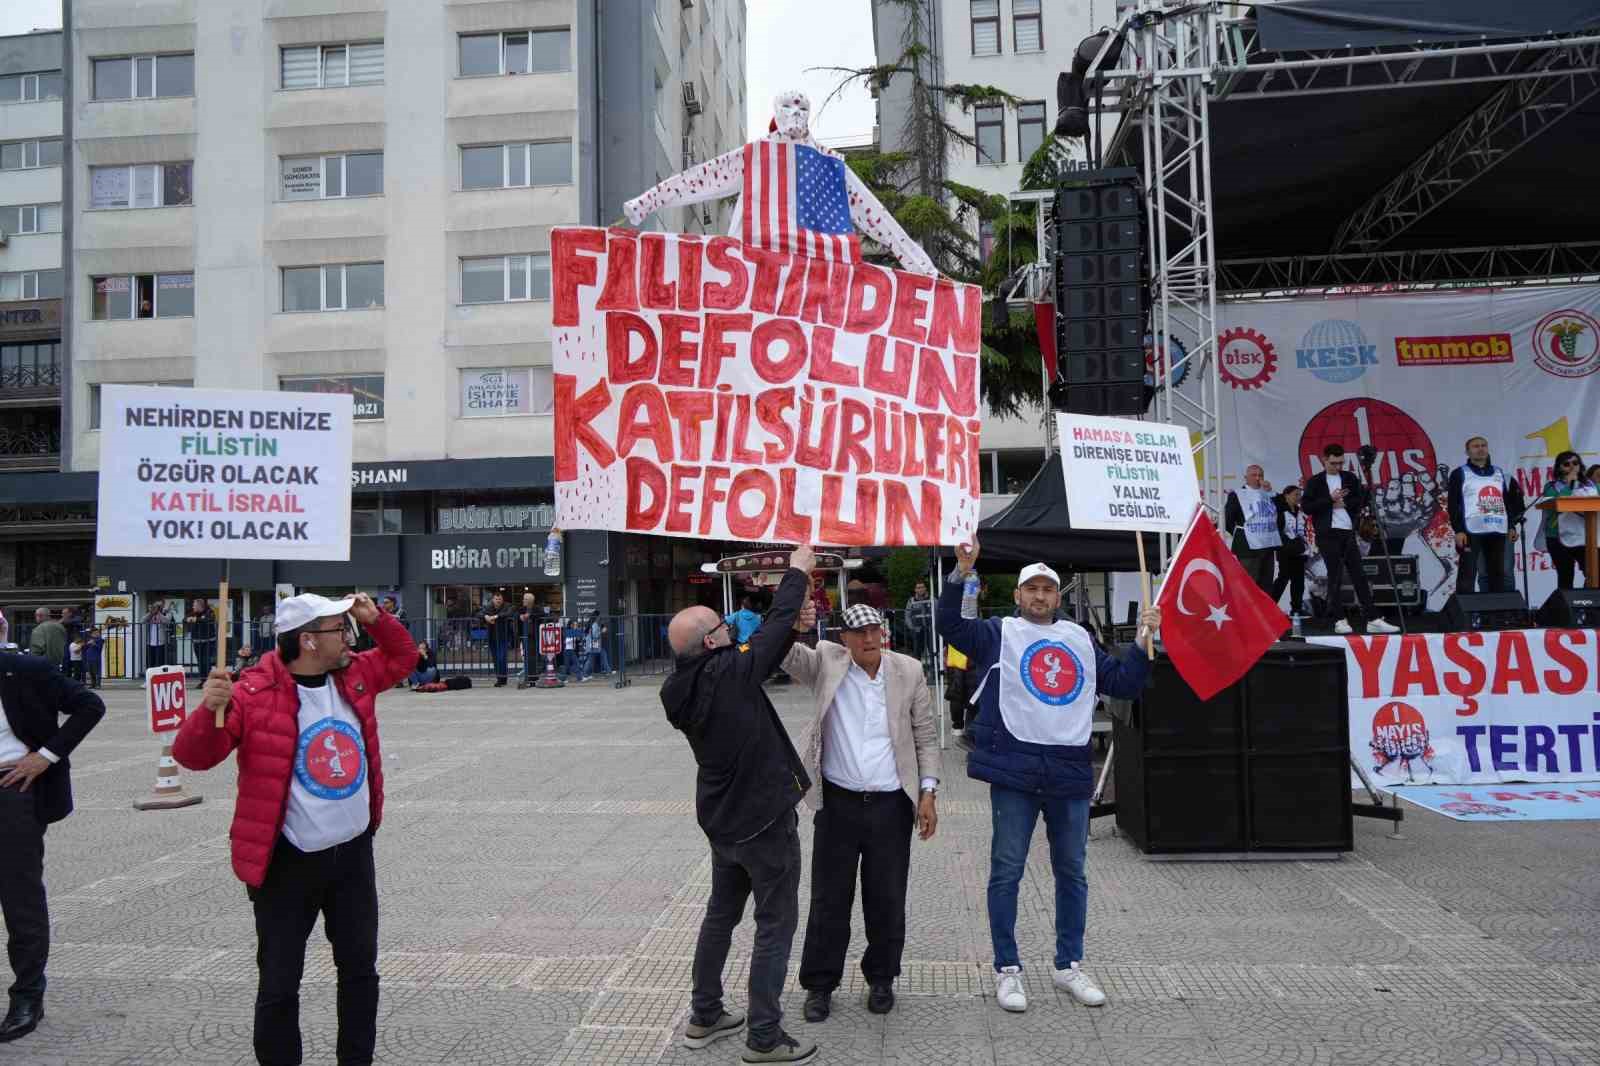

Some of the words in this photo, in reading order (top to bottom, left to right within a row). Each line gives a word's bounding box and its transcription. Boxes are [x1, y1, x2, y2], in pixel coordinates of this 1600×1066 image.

[1296, 345, 1379, 369] KESK
[1398, 336, 1510, 358] tmmob
[606, 311, 978, 418] DEFOLUN
[125, 404, 243, 429] NEHİRDEN
[249, 407, 332, 431] DENİZE
[180, 432, 278, 457] FİLİSTİN
[1072, 427, 1134, 445] HAMAS'A
[1135, 432, 1177, 448] SELAM
[1073, 443, 1133, 464] DİRENİŞE
[1135, 449, 1183, 466] DEVAM!
[137, 457, 215, 483] ÖZGÜR
[221, 465, 319, 485] OLACAK
[1107, 463, 1160, 482] FİLİSTİN
[151, 488, 223, 513] KATİL
[228, 489, 305, 514] İSRAİL
[626, 457, 941, 545] DEFOLUN
[1112, 485, 1161, 501] YALNIZ
[1108, 502, 1170, 520] DEĞİLDİR.
[147, 519, 203, 540] YOK!
[210, 521, 309, 540] OLACAK
[431, 545, 492, 569] BUĞRA
[1345, 627, 1600, 717] YAŞAS
[152, 680, 184, 712] WC
[1392, 704, 1400, 723] 1
[1376, 723, 1424, 740] MAYIS
